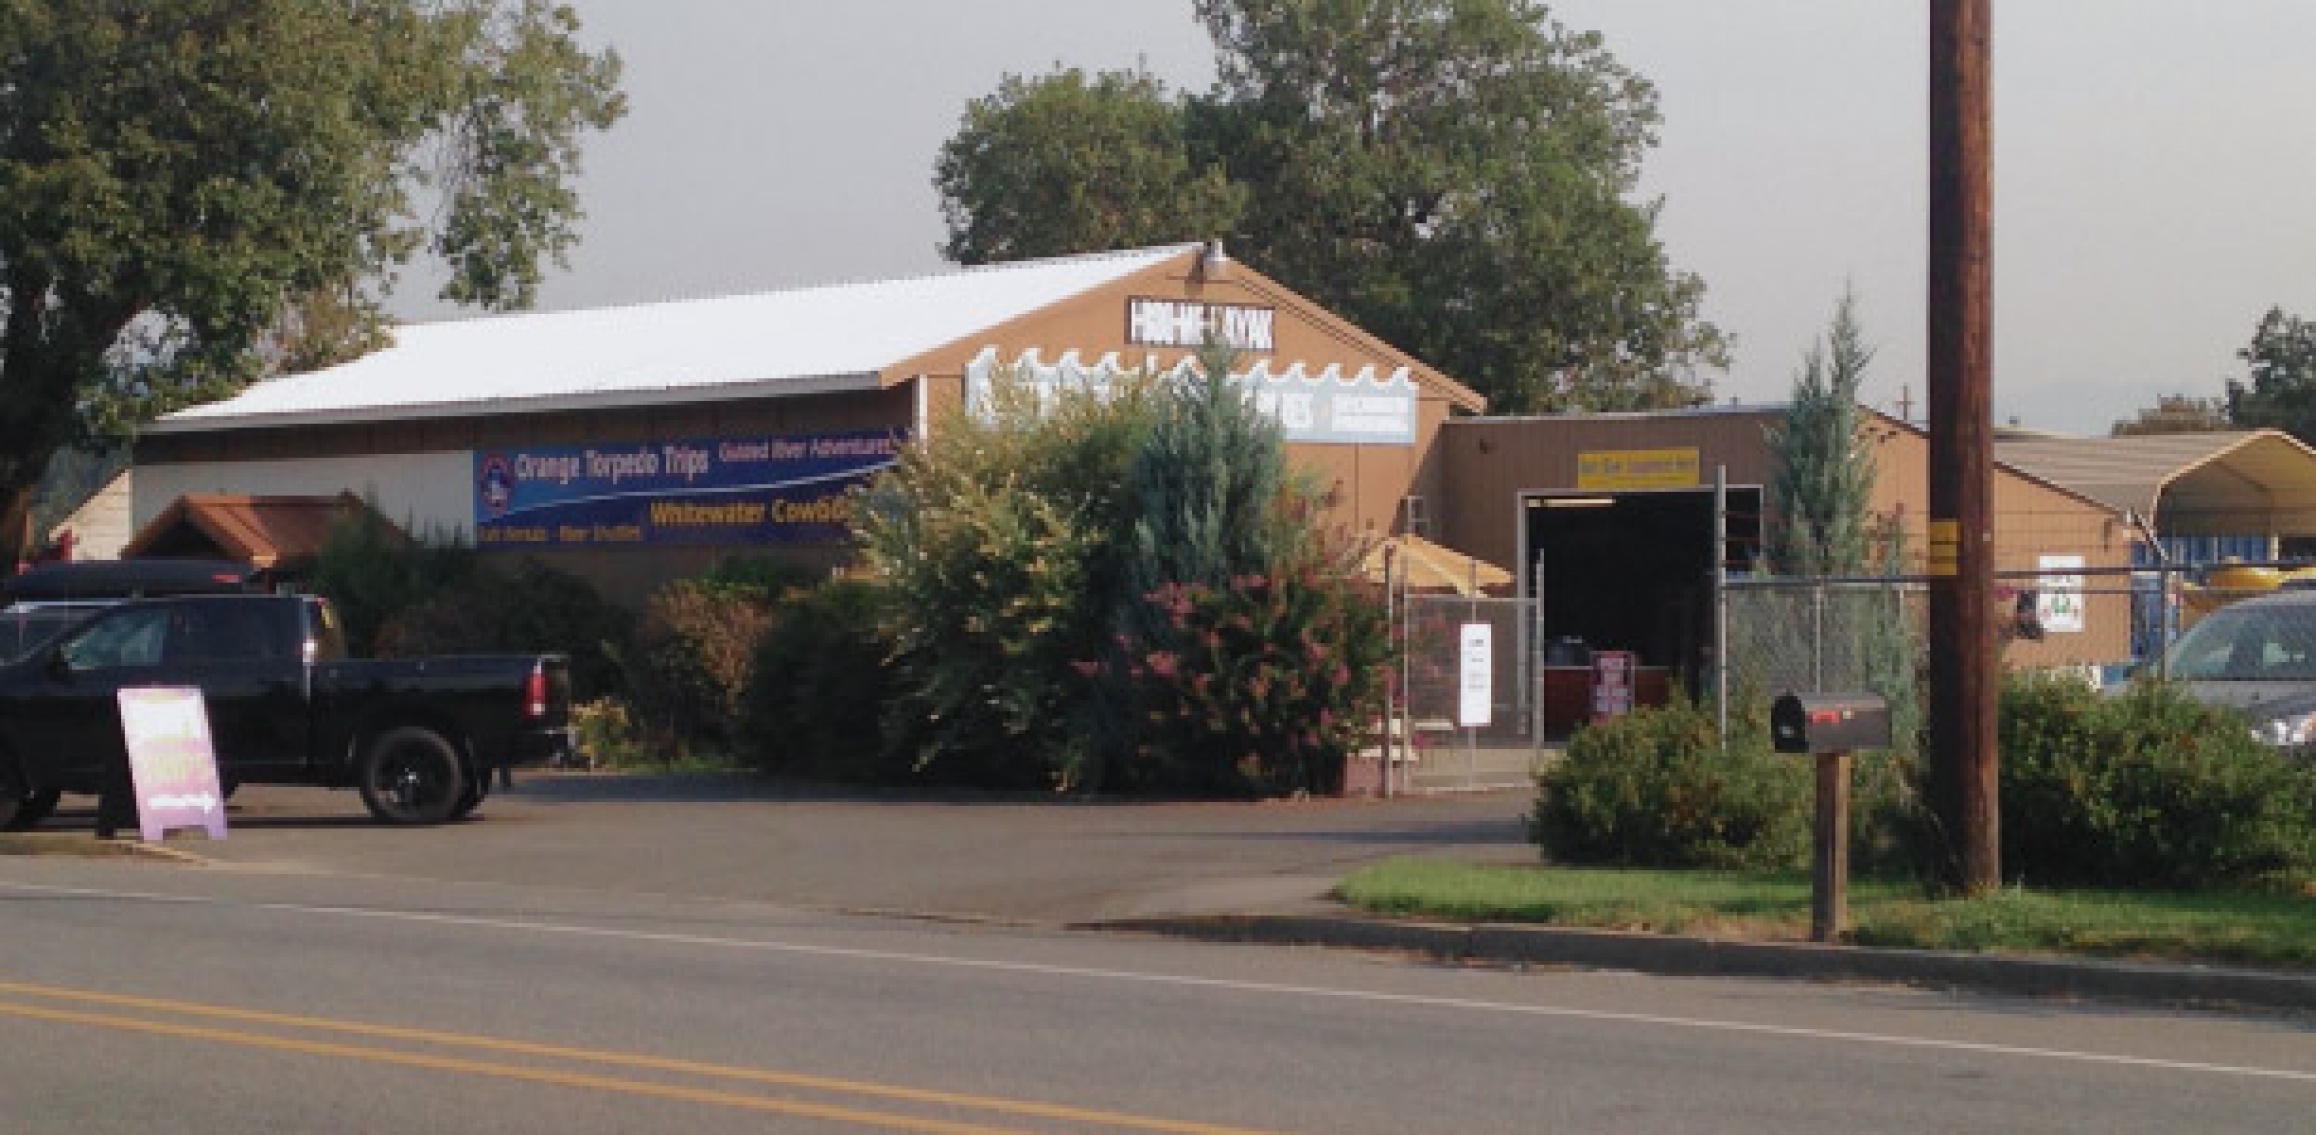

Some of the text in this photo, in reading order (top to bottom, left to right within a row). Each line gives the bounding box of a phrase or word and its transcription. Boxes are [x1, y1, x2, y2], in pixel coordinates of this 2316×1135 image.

[515, 446, 709, 484] Orange Torpedo Trips
[650, 502, 765, 525] Whitewater
